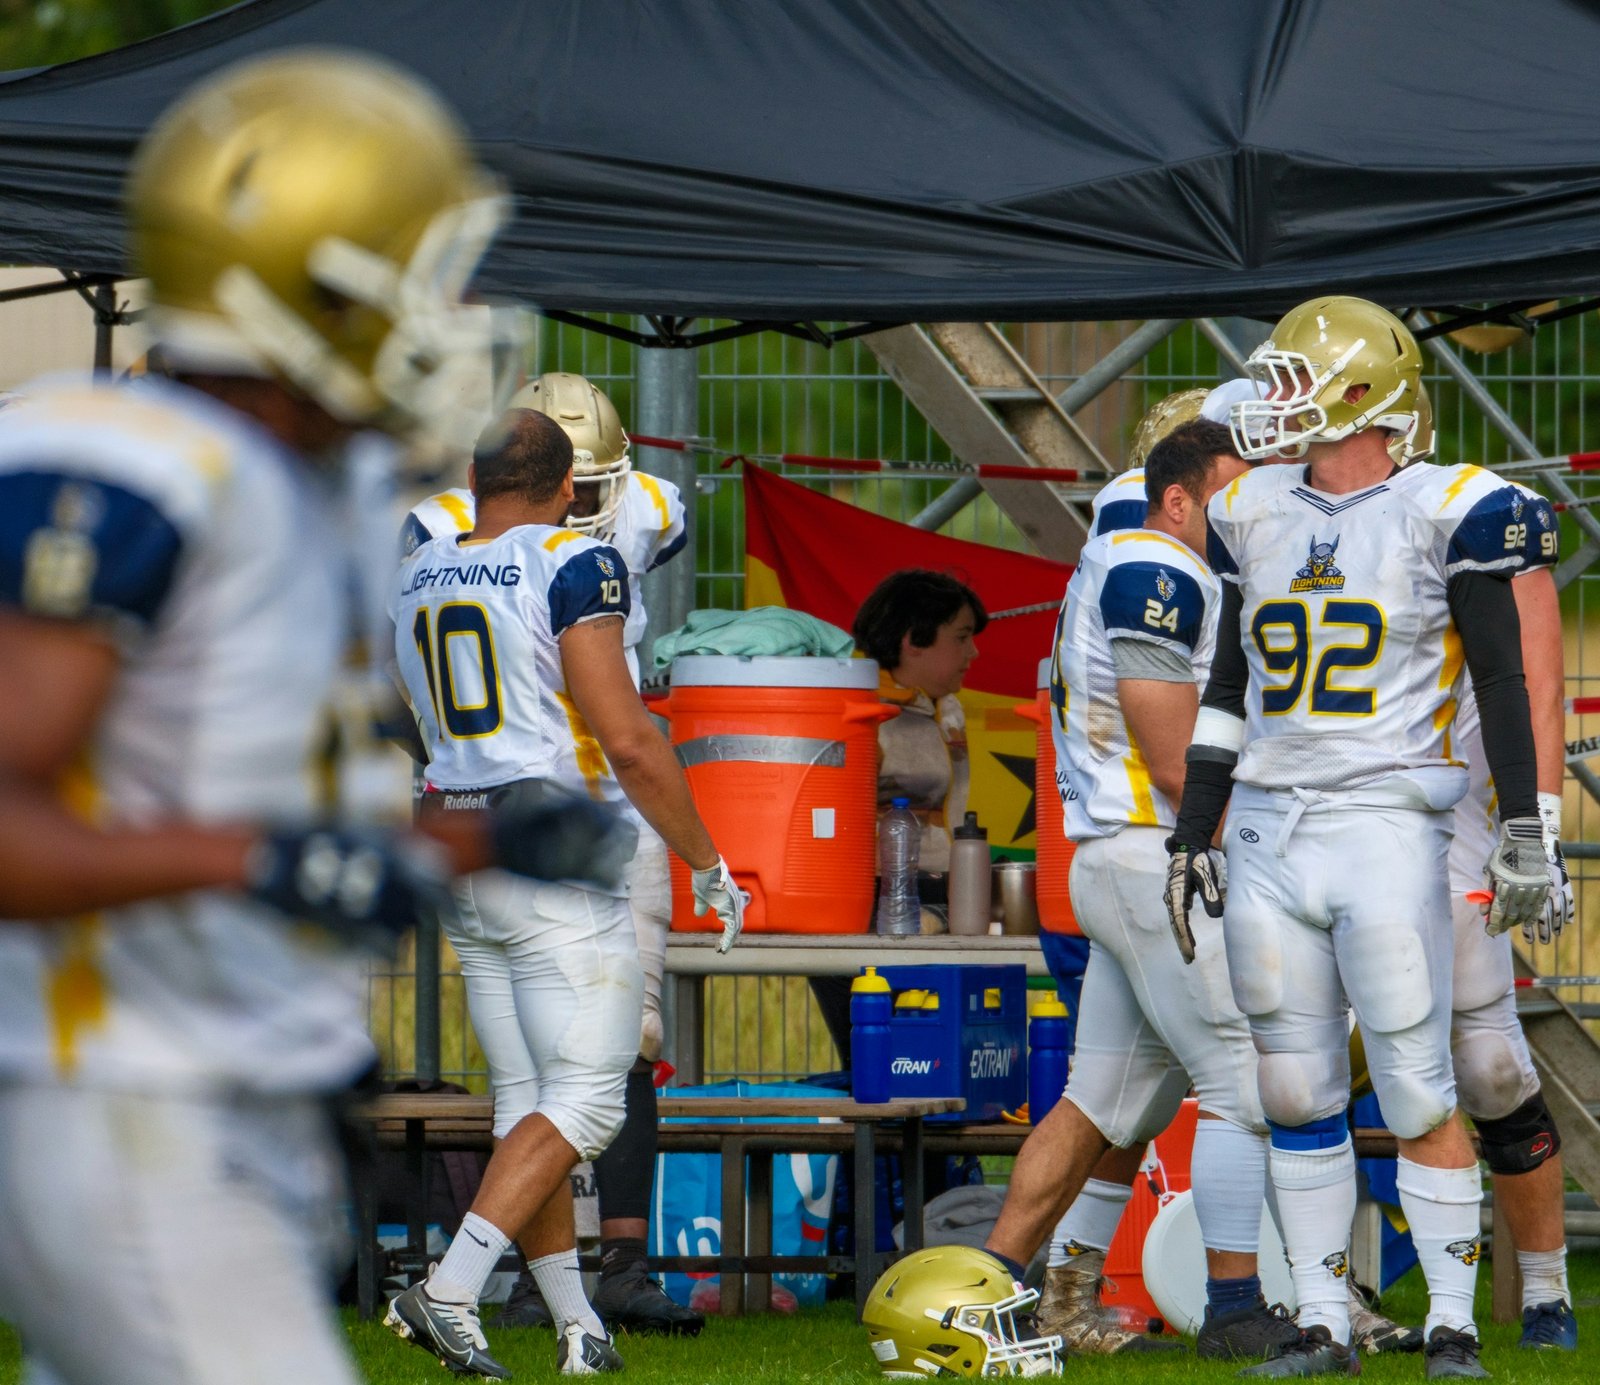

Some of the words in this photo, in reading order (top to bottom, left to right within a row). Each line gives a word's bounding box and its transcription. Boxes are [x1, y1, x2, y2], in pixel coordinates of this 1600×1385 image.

[1503, 522, 1527, 549] 92
[401, 564, 521, 596] LIGHTNING
[600, 579, 621, 604] 10
[1290, 576, 1344, 591] LIGHTNING
[1143, 598, 1179, 633] 24
[413, 601, 503, 742] 10
[1251, 598, 1387, 717] 92
[443, 794, 487, 809] Riddell
[970, 1048, 1010, 1078] EXTRAN
